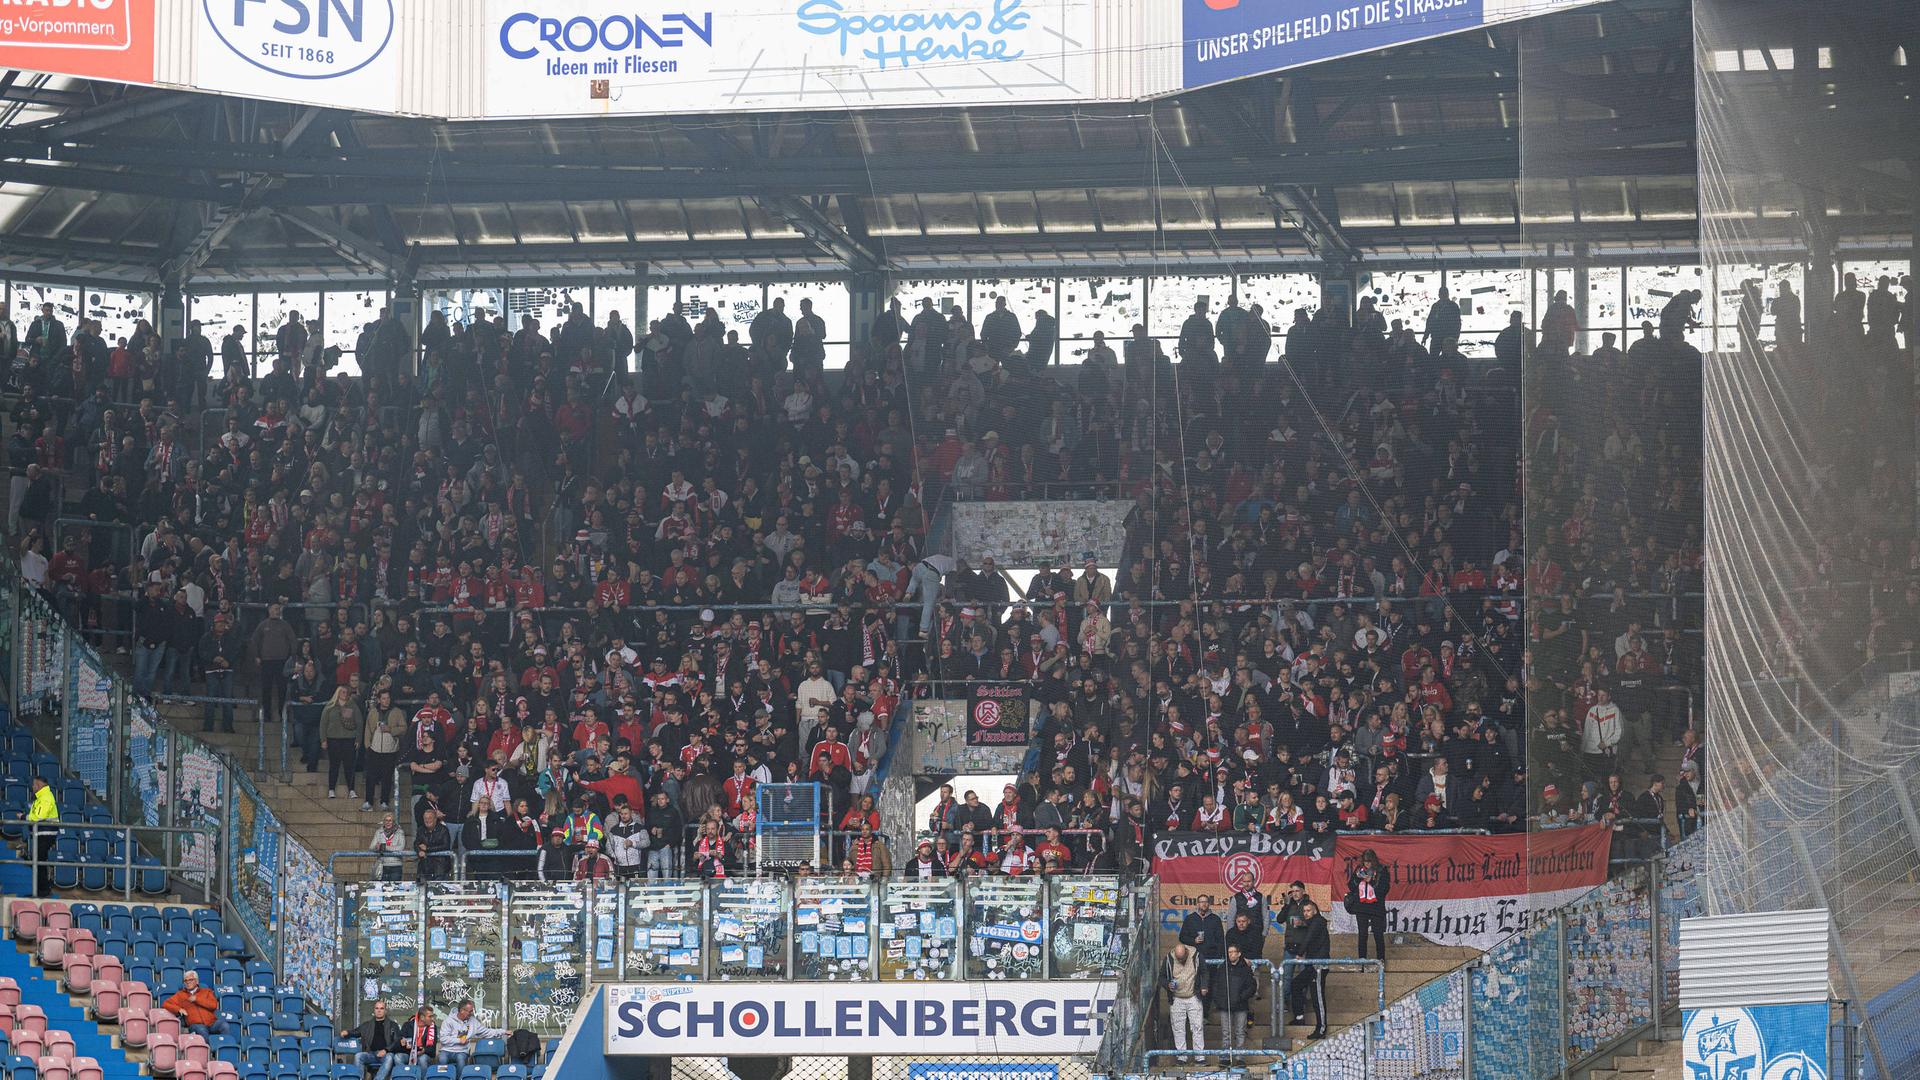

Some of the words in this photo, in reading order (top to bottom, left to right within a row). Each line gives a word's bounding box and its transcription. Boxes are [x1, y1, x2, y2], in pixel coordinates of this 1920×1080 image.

[500, 12, 712, 60] CROONEN
[797, 0, 982, 56] Spaans
[1197, 32, 1249, 62] UNSER
[1252, 14, 1332, 50] SPIELFELD
[1336, 7, 1359, 31] IST
[1364, 1, 1390, 25] DIE
[262, 42, 293, 58] SEIT
[299, 47, 334, 64] 1868
[863, 32, 1024, 69] Henke
[547, 57, 588, 76] Ideen
[593, 57, 618, 74] mit
[624, 55, 677, 74] Fliesen
[977, 685, 1022, 697] Sektion
[972, 730, 1025, 743] Flandern
[1406, 863, 1441, 885] uns
[1446, 856, 1476, 883] das
[1481, 852, 1520, 880] Land
[387, 933, 417, 942] SUPTRAS
[543, 934, 574, 943] SUPTRAS
[976, 926, 1020, 939] JUGEND
[439, 951, 469, 962] SUPTRAS
[541, 952, 571, 963] SUPTRAS
